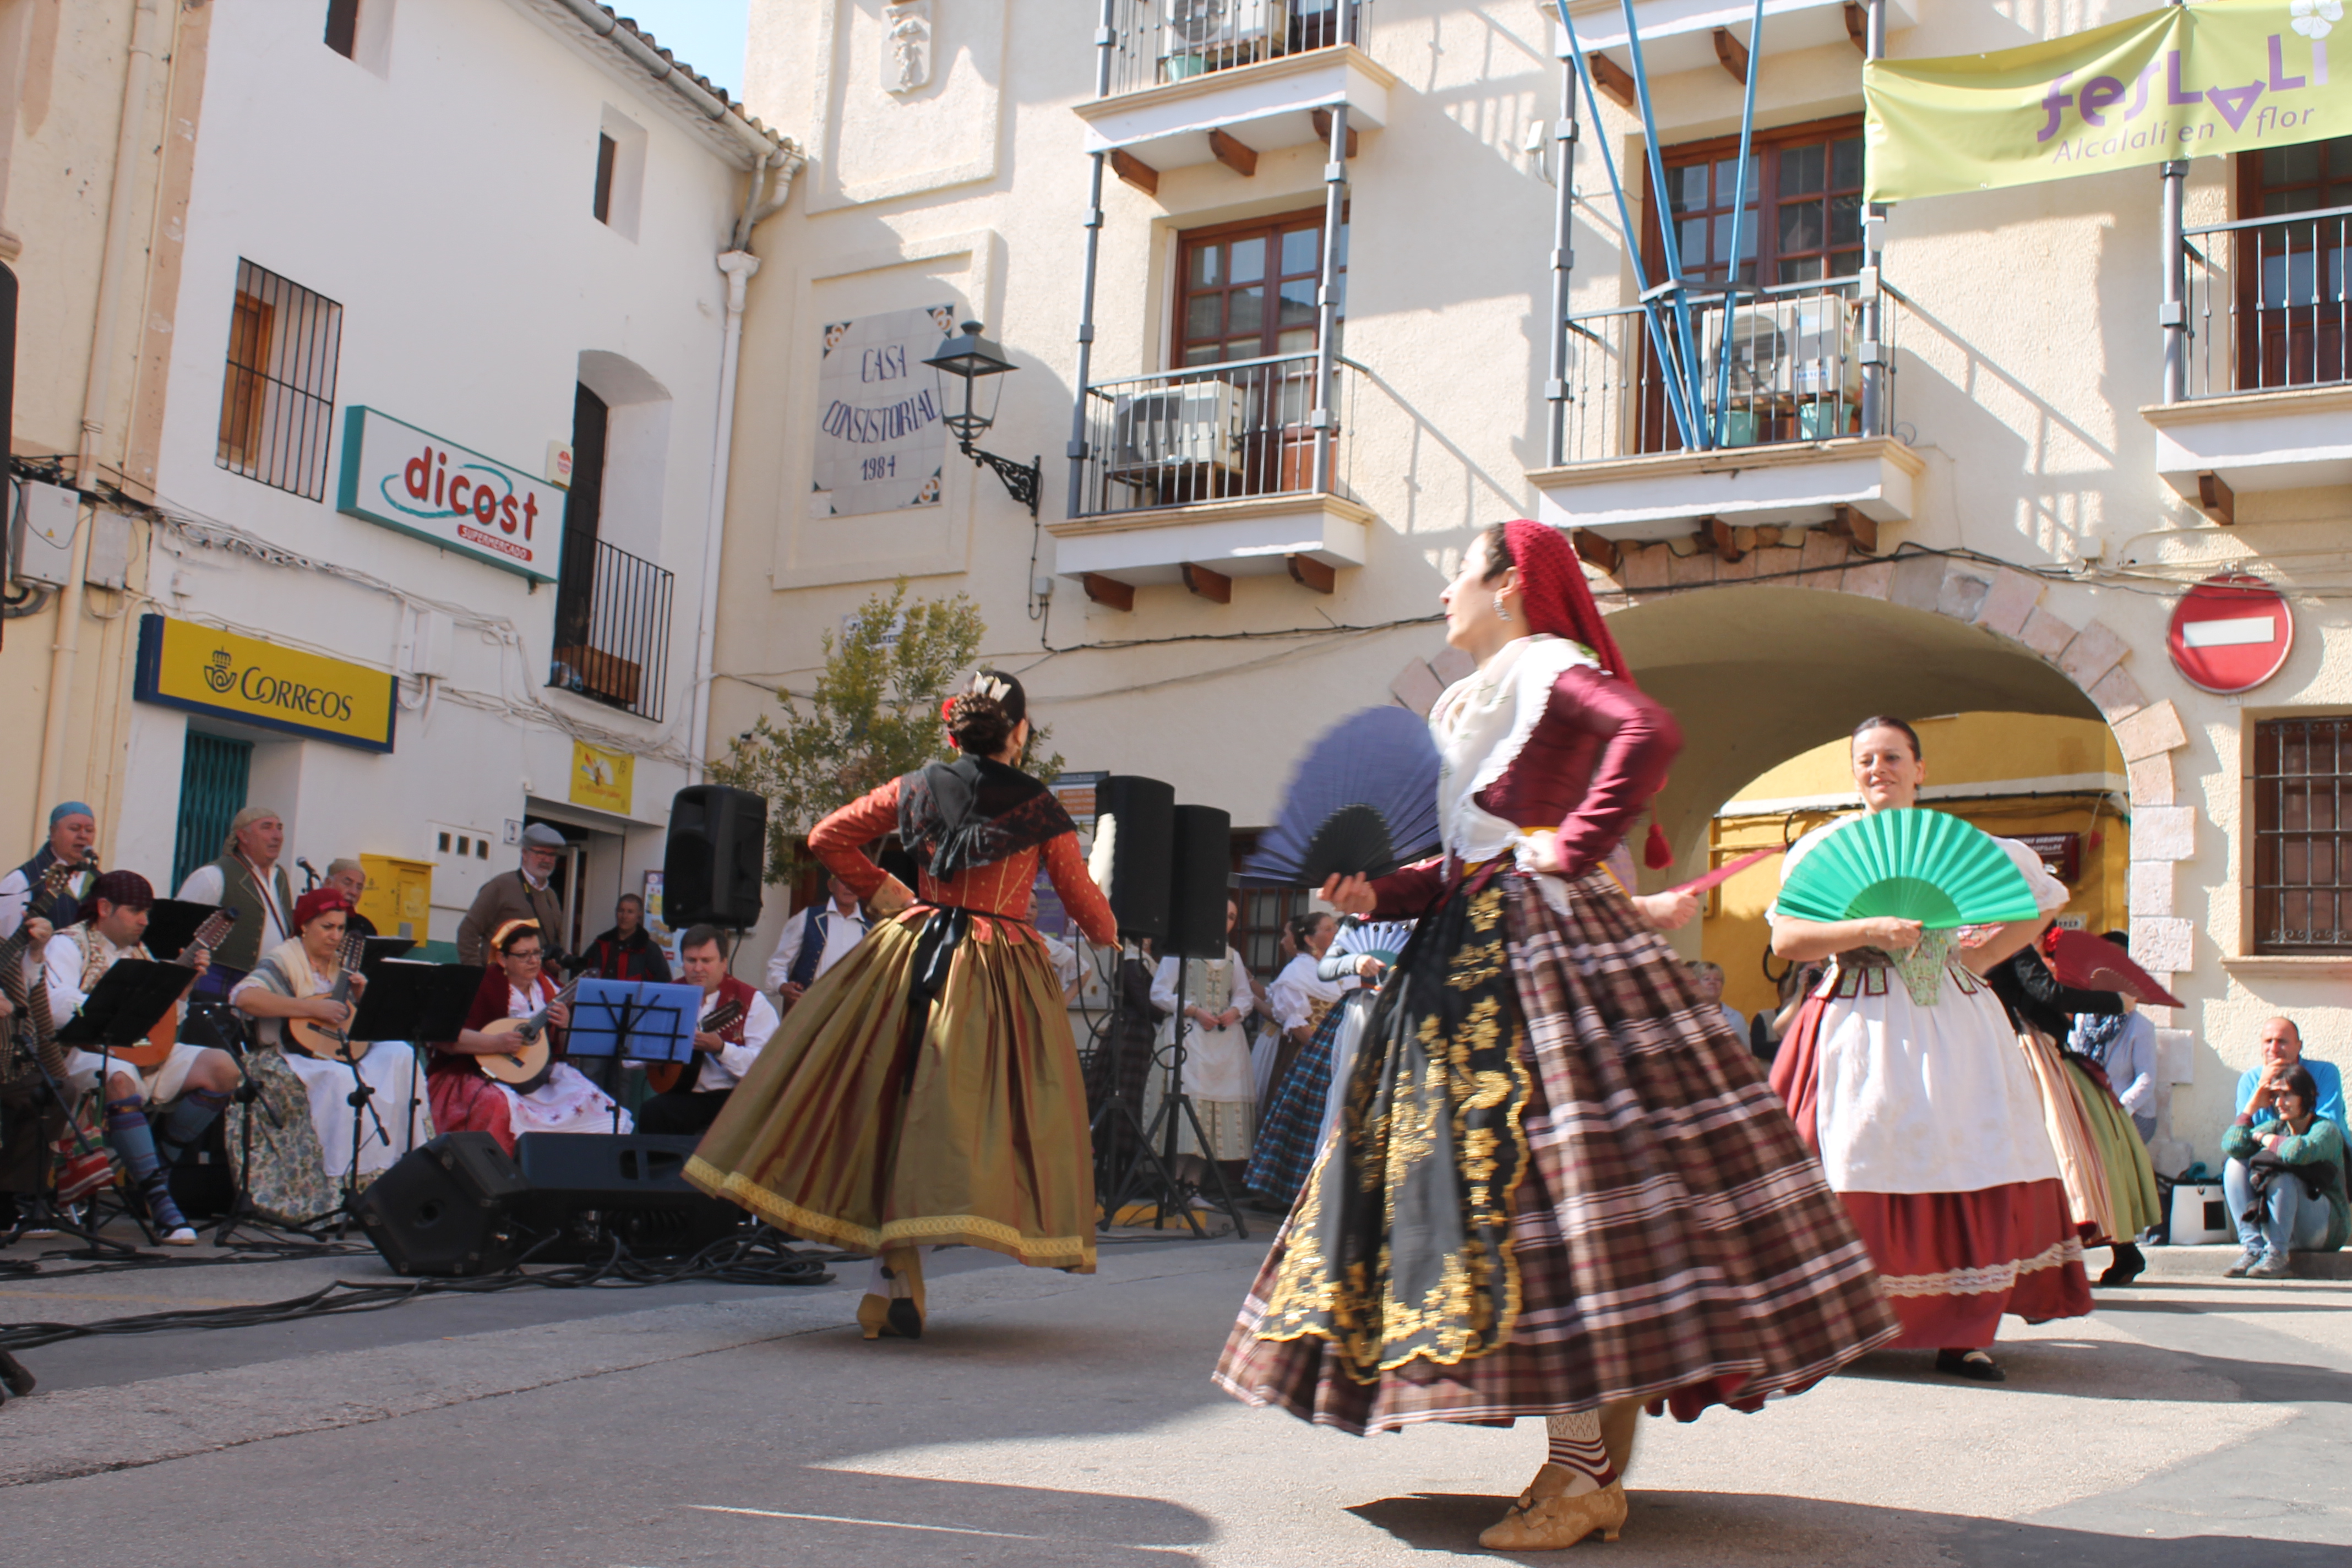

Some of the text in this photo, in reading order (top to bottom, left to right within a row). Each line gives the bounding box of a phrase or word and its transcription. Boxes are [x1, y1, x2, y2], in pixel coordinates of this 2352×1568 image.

[2052, 106, 2315, 164] Alcalalí en flor
[862, 344, 907, 383] CASA
[822, 388, 943, 443] CONSISTORIAL
[405, 446, 538, 541] dicost
[861, 454, 896, 481] 1984
[460, 527, 527, 560] SUPERMERCADO
[241, 666, 353, 722] CORREOS
